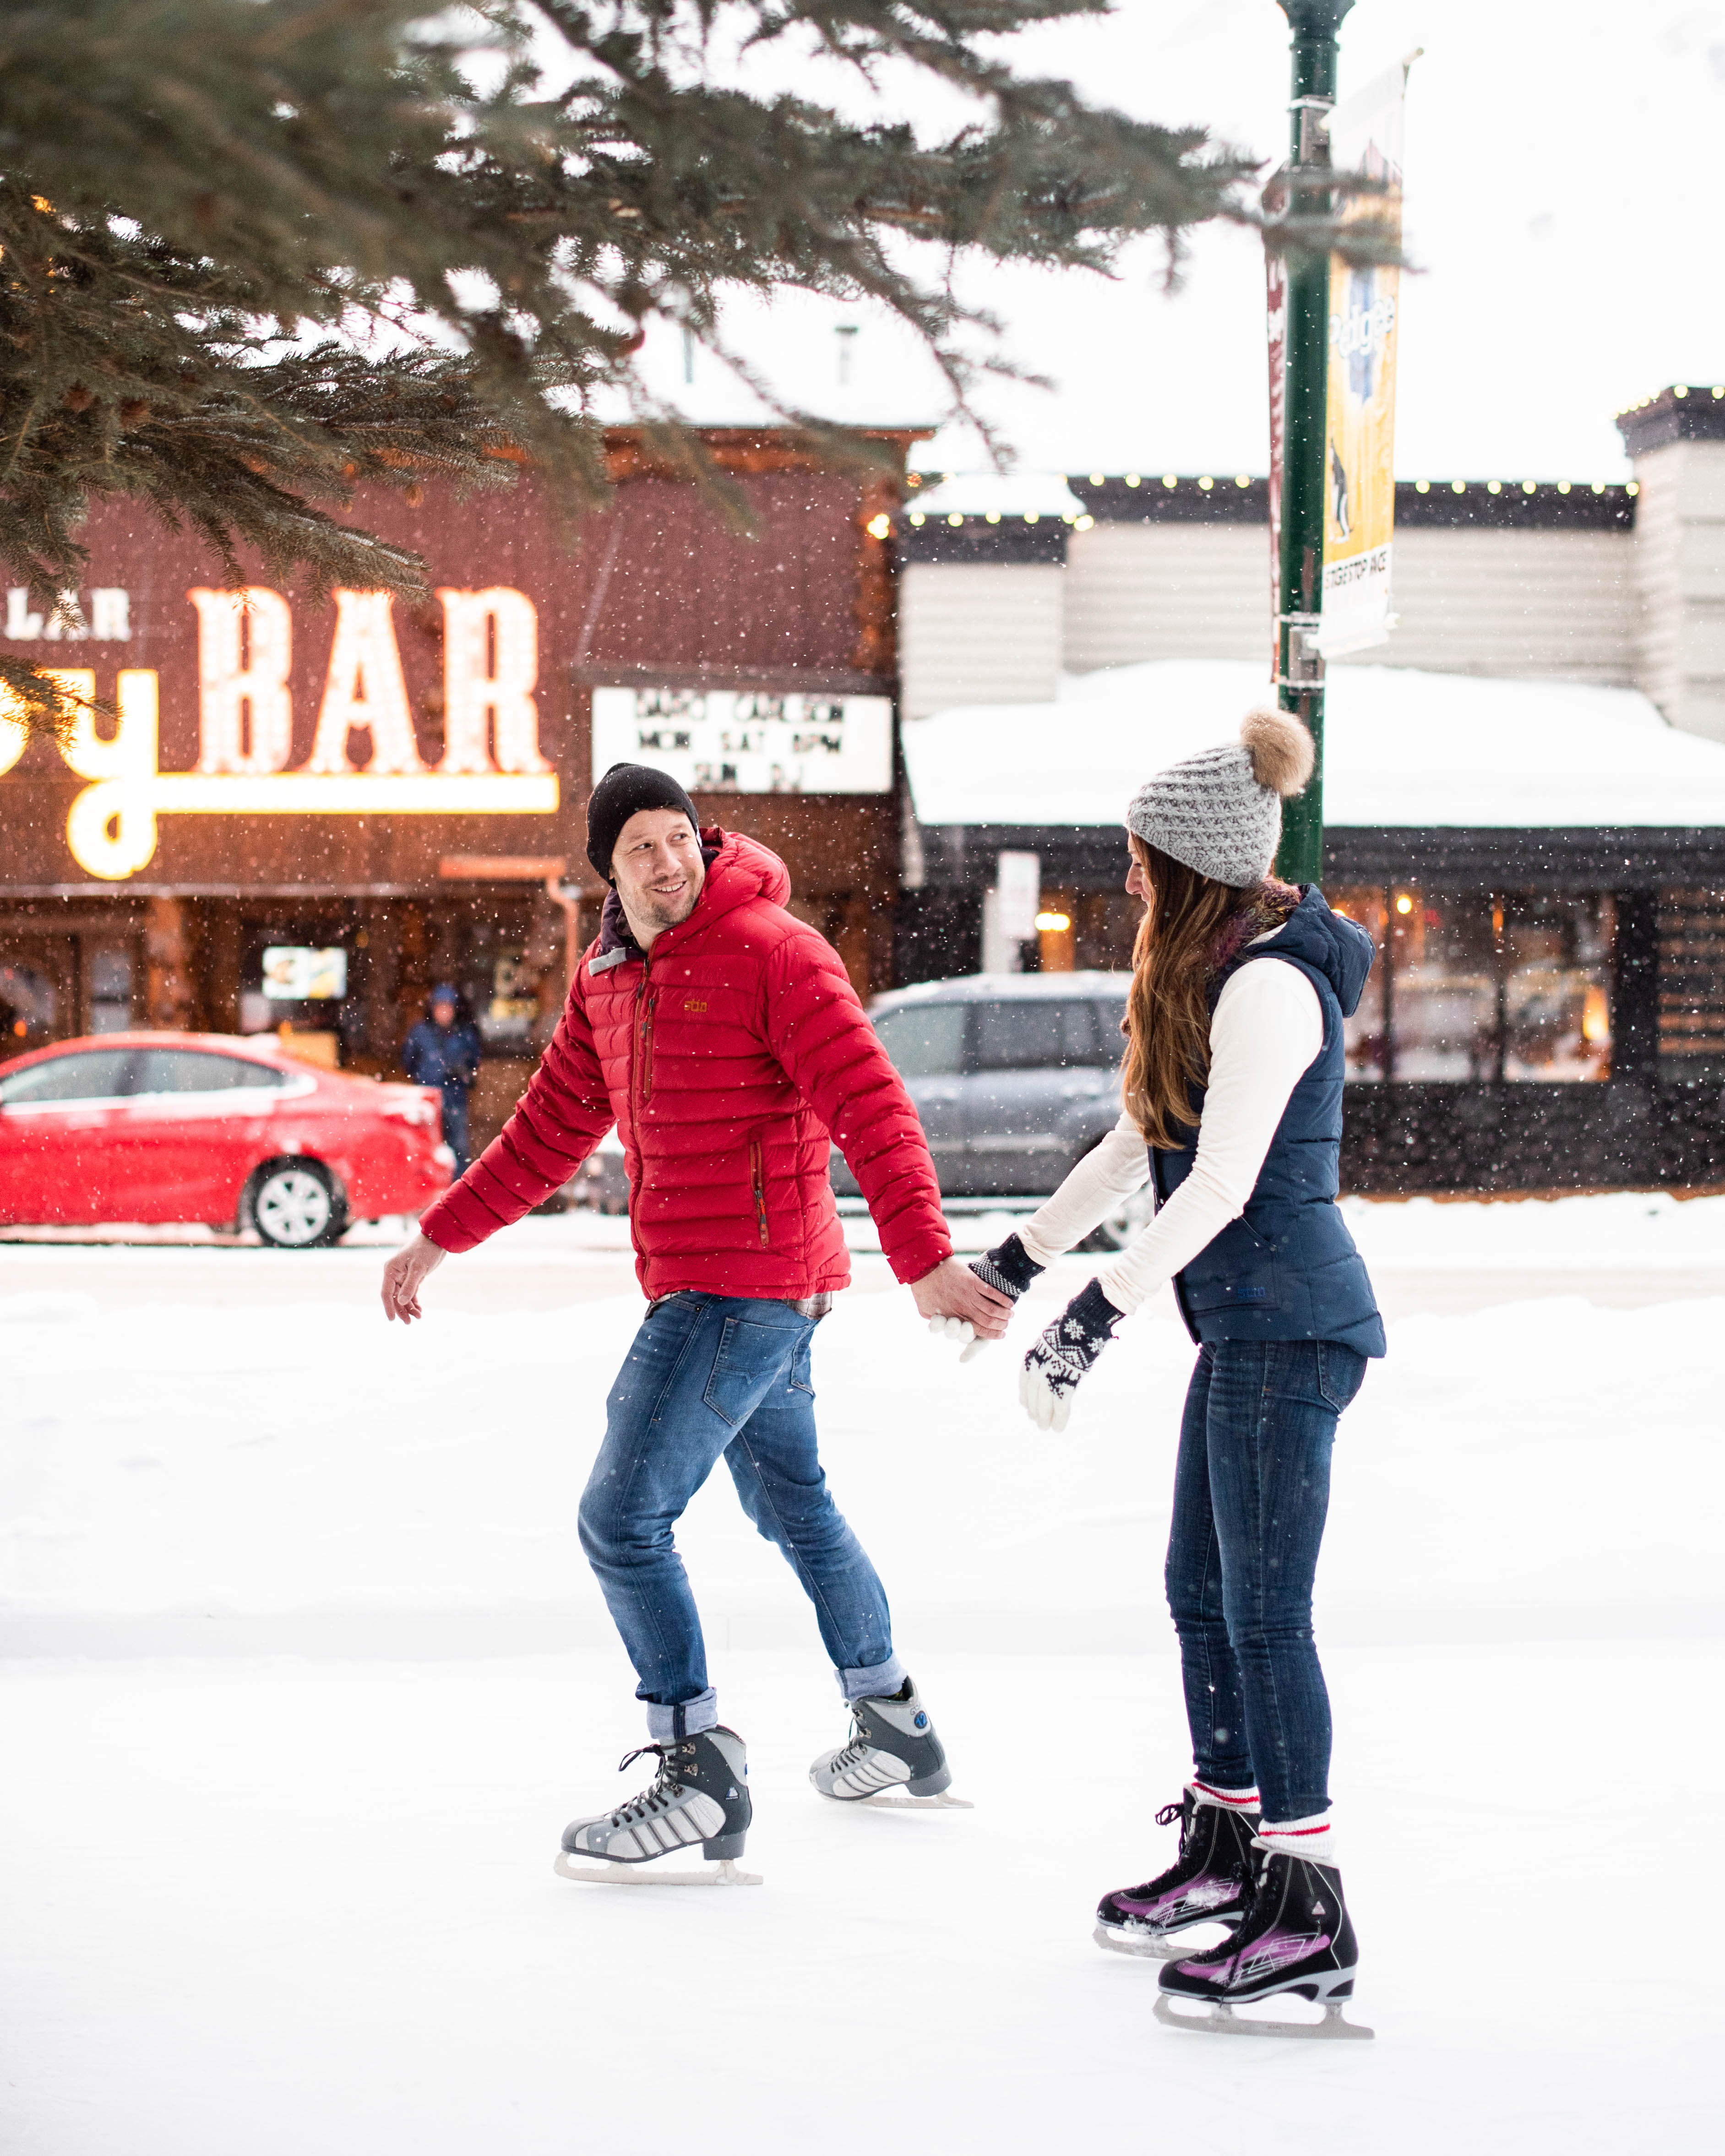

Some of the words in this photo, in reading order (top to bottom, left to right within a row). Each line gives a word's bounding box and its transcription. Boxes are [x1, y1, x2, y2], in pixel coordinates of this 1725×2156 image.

[186, 586, 555, 774] BAR
[639, 730, 691, 750] MON
[720, 731, 765, 752] SAT
